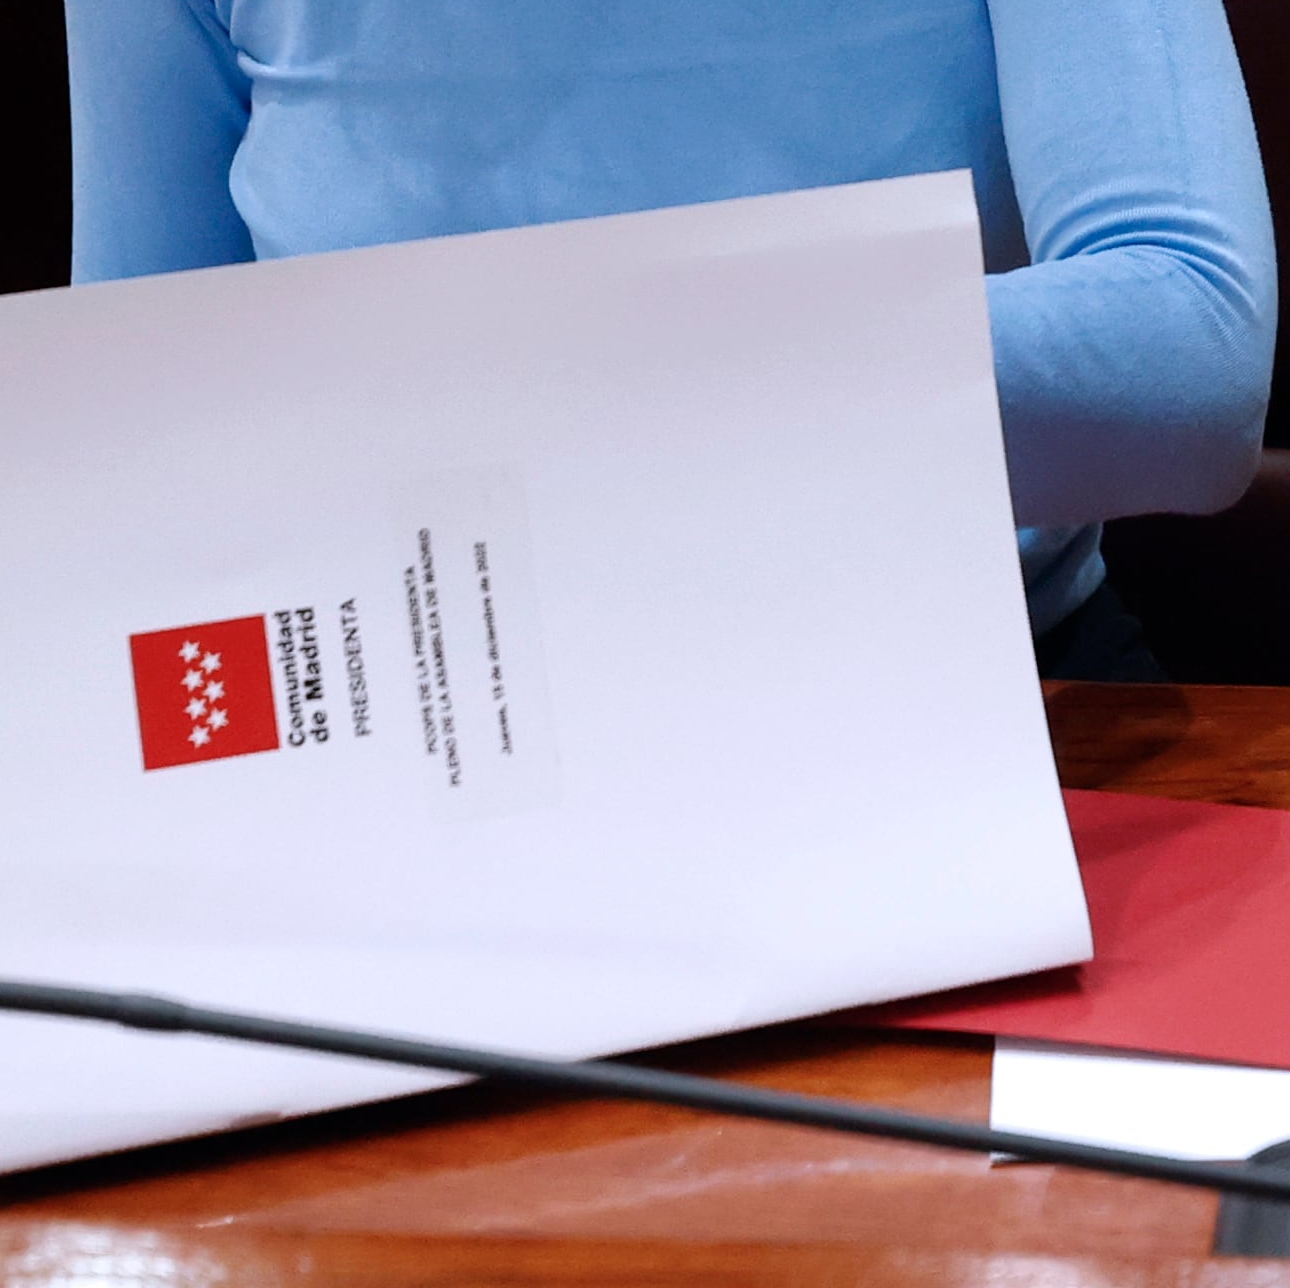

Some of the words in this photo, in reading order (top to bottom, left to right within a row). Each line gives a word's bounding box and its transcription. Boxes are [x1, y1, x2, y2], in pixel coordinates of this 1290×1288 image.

[417, 527, 435, 585] MADRID
[274, 610, 306, 747] Comunidad
[295, 606, 324, 701] Madrid
[340, 597, 373, 738] PRESIDENTA
[309, 709, 330, 744] de
